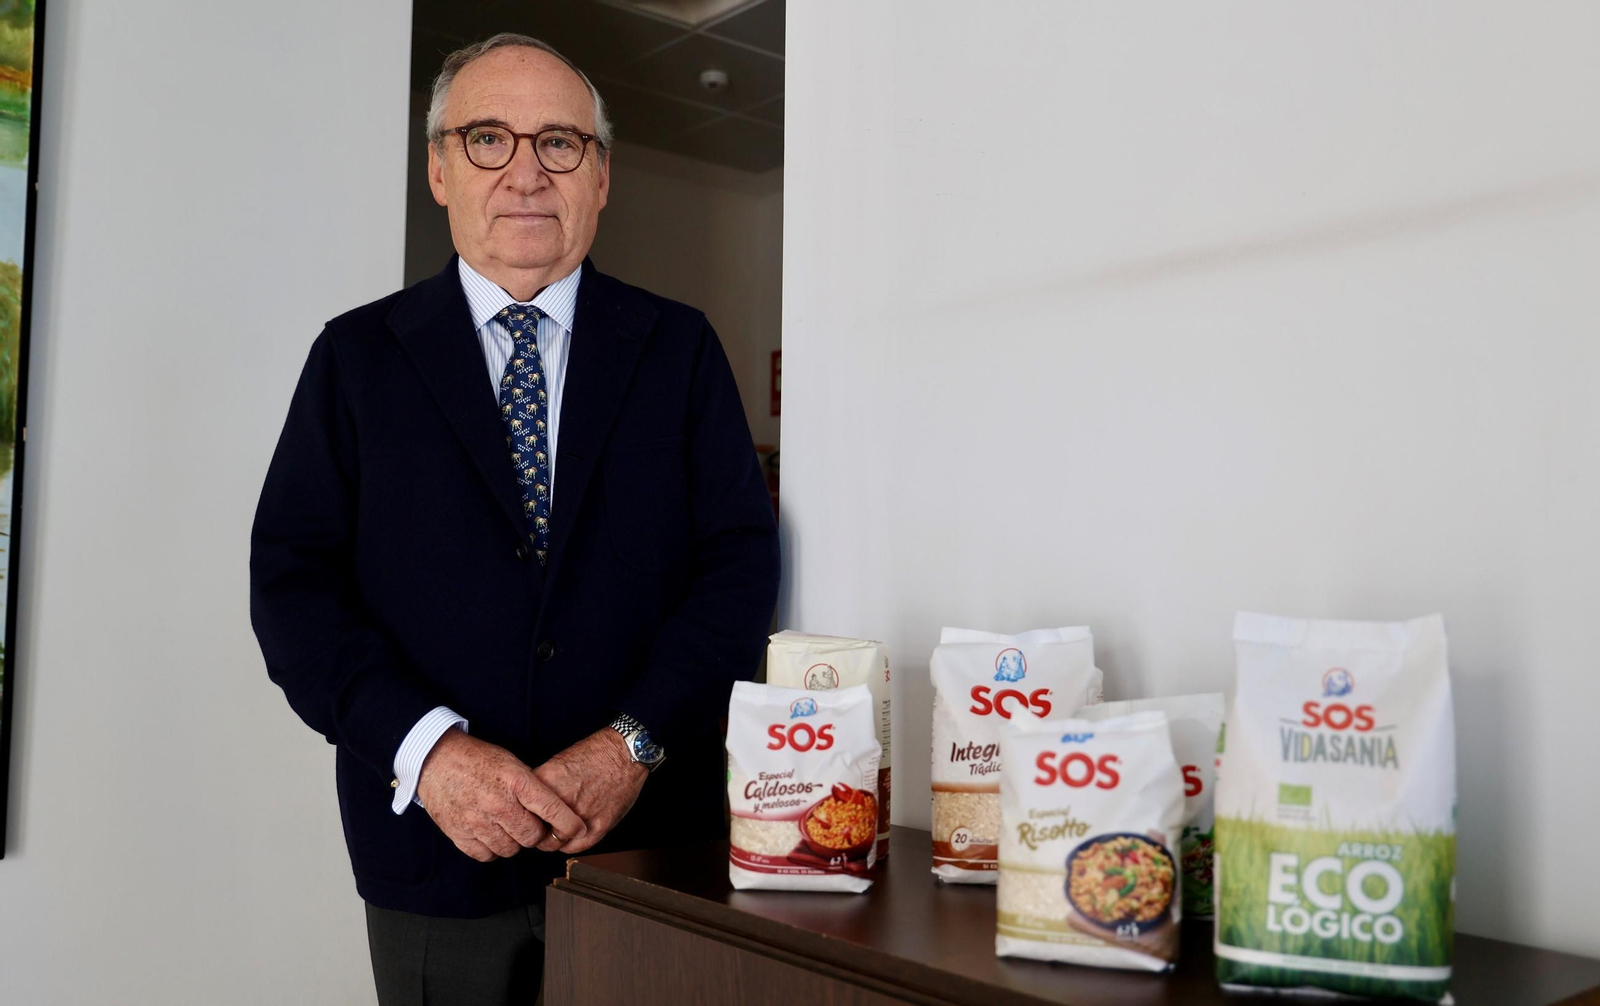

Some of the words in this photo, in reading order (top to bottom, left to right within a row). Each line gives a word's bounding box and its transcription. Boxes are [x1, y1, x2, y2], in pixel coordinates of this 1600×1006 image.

[969, 685, 1052, 719] SOS
[1303, 701, 1375, 732] SOS
[767, 722, 835, 752] SOS
[1279, 726, 1399, 769] VIDASANIA
[950, 740, 1000, 763] Integ
[758, 768, 795, 781] Especial
[969, 761, 1002, 776] Tradic
[1034, 751, 1121, 790] SOS
[744, 780, 823, 801] Caldosos
[753, 802, 763, 813] y
[762, 798, 807, 810] melosos
[954, 833, 968, 844] 20
[1017, 818, 1092, 851] Risotto
[1337, 841, 1403, 860] ARROZ
[1268, 852, 1404, 915] ECO
